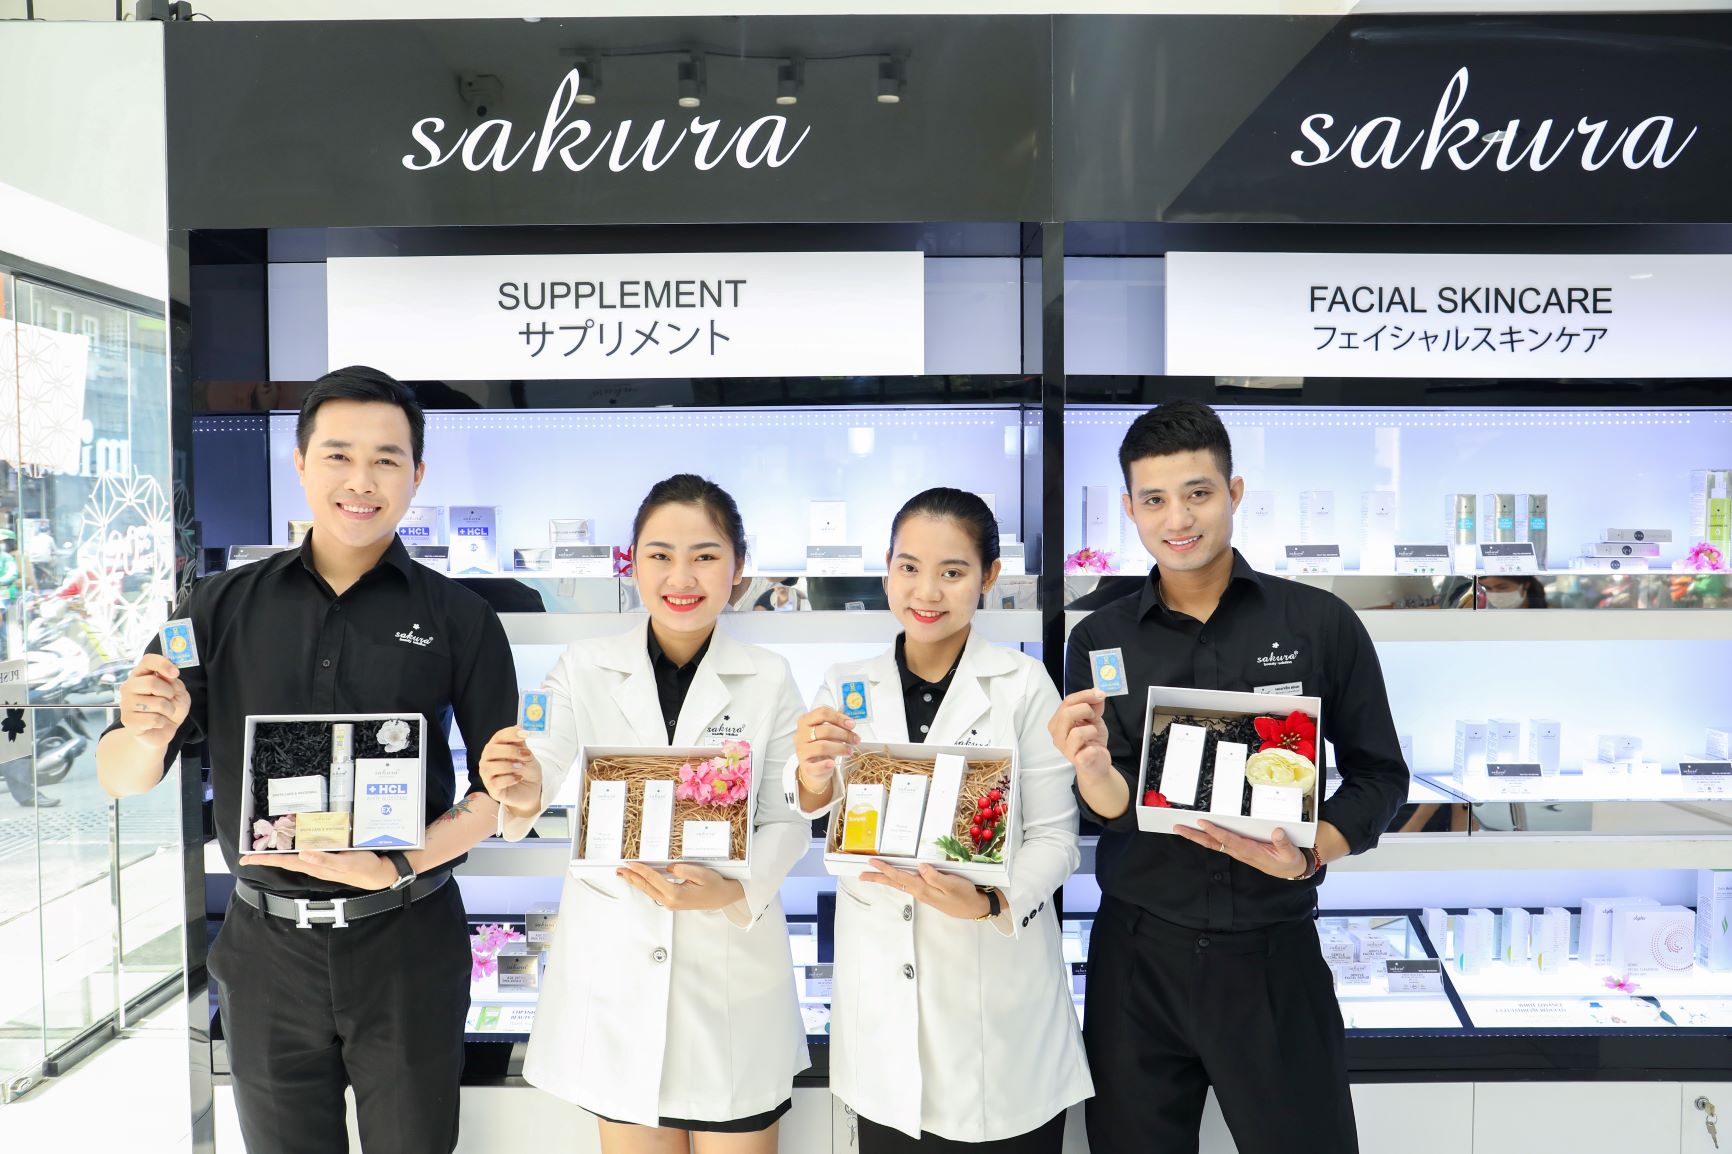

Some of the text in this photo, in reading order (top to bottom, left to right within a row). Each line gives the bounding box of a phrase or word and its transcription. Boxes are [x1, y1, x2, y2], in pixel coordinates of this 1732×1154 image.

[402, 68, 810, 172] sakura
[1291, 67, 1697, 171] sakura
[498, 279, 747, 310] SUPPLEMENT
[1310, 285, 1613, 315] FACIAL SKINCARE
[518, 318, 730, 358] サプリメント
[1313, 325, 1609, 353] フェイシャルスキンケア
[408, 527, 429, 536] HCL
[467, 527, 488, 536] HCL
[394, 630, 433, 645] sakura
[1256, 651, 1298, 664] sakura
[706, 722, 743, 734] sakura
[379, 784, 406, 794] HCL
[381, 806, 391, 815] EX
